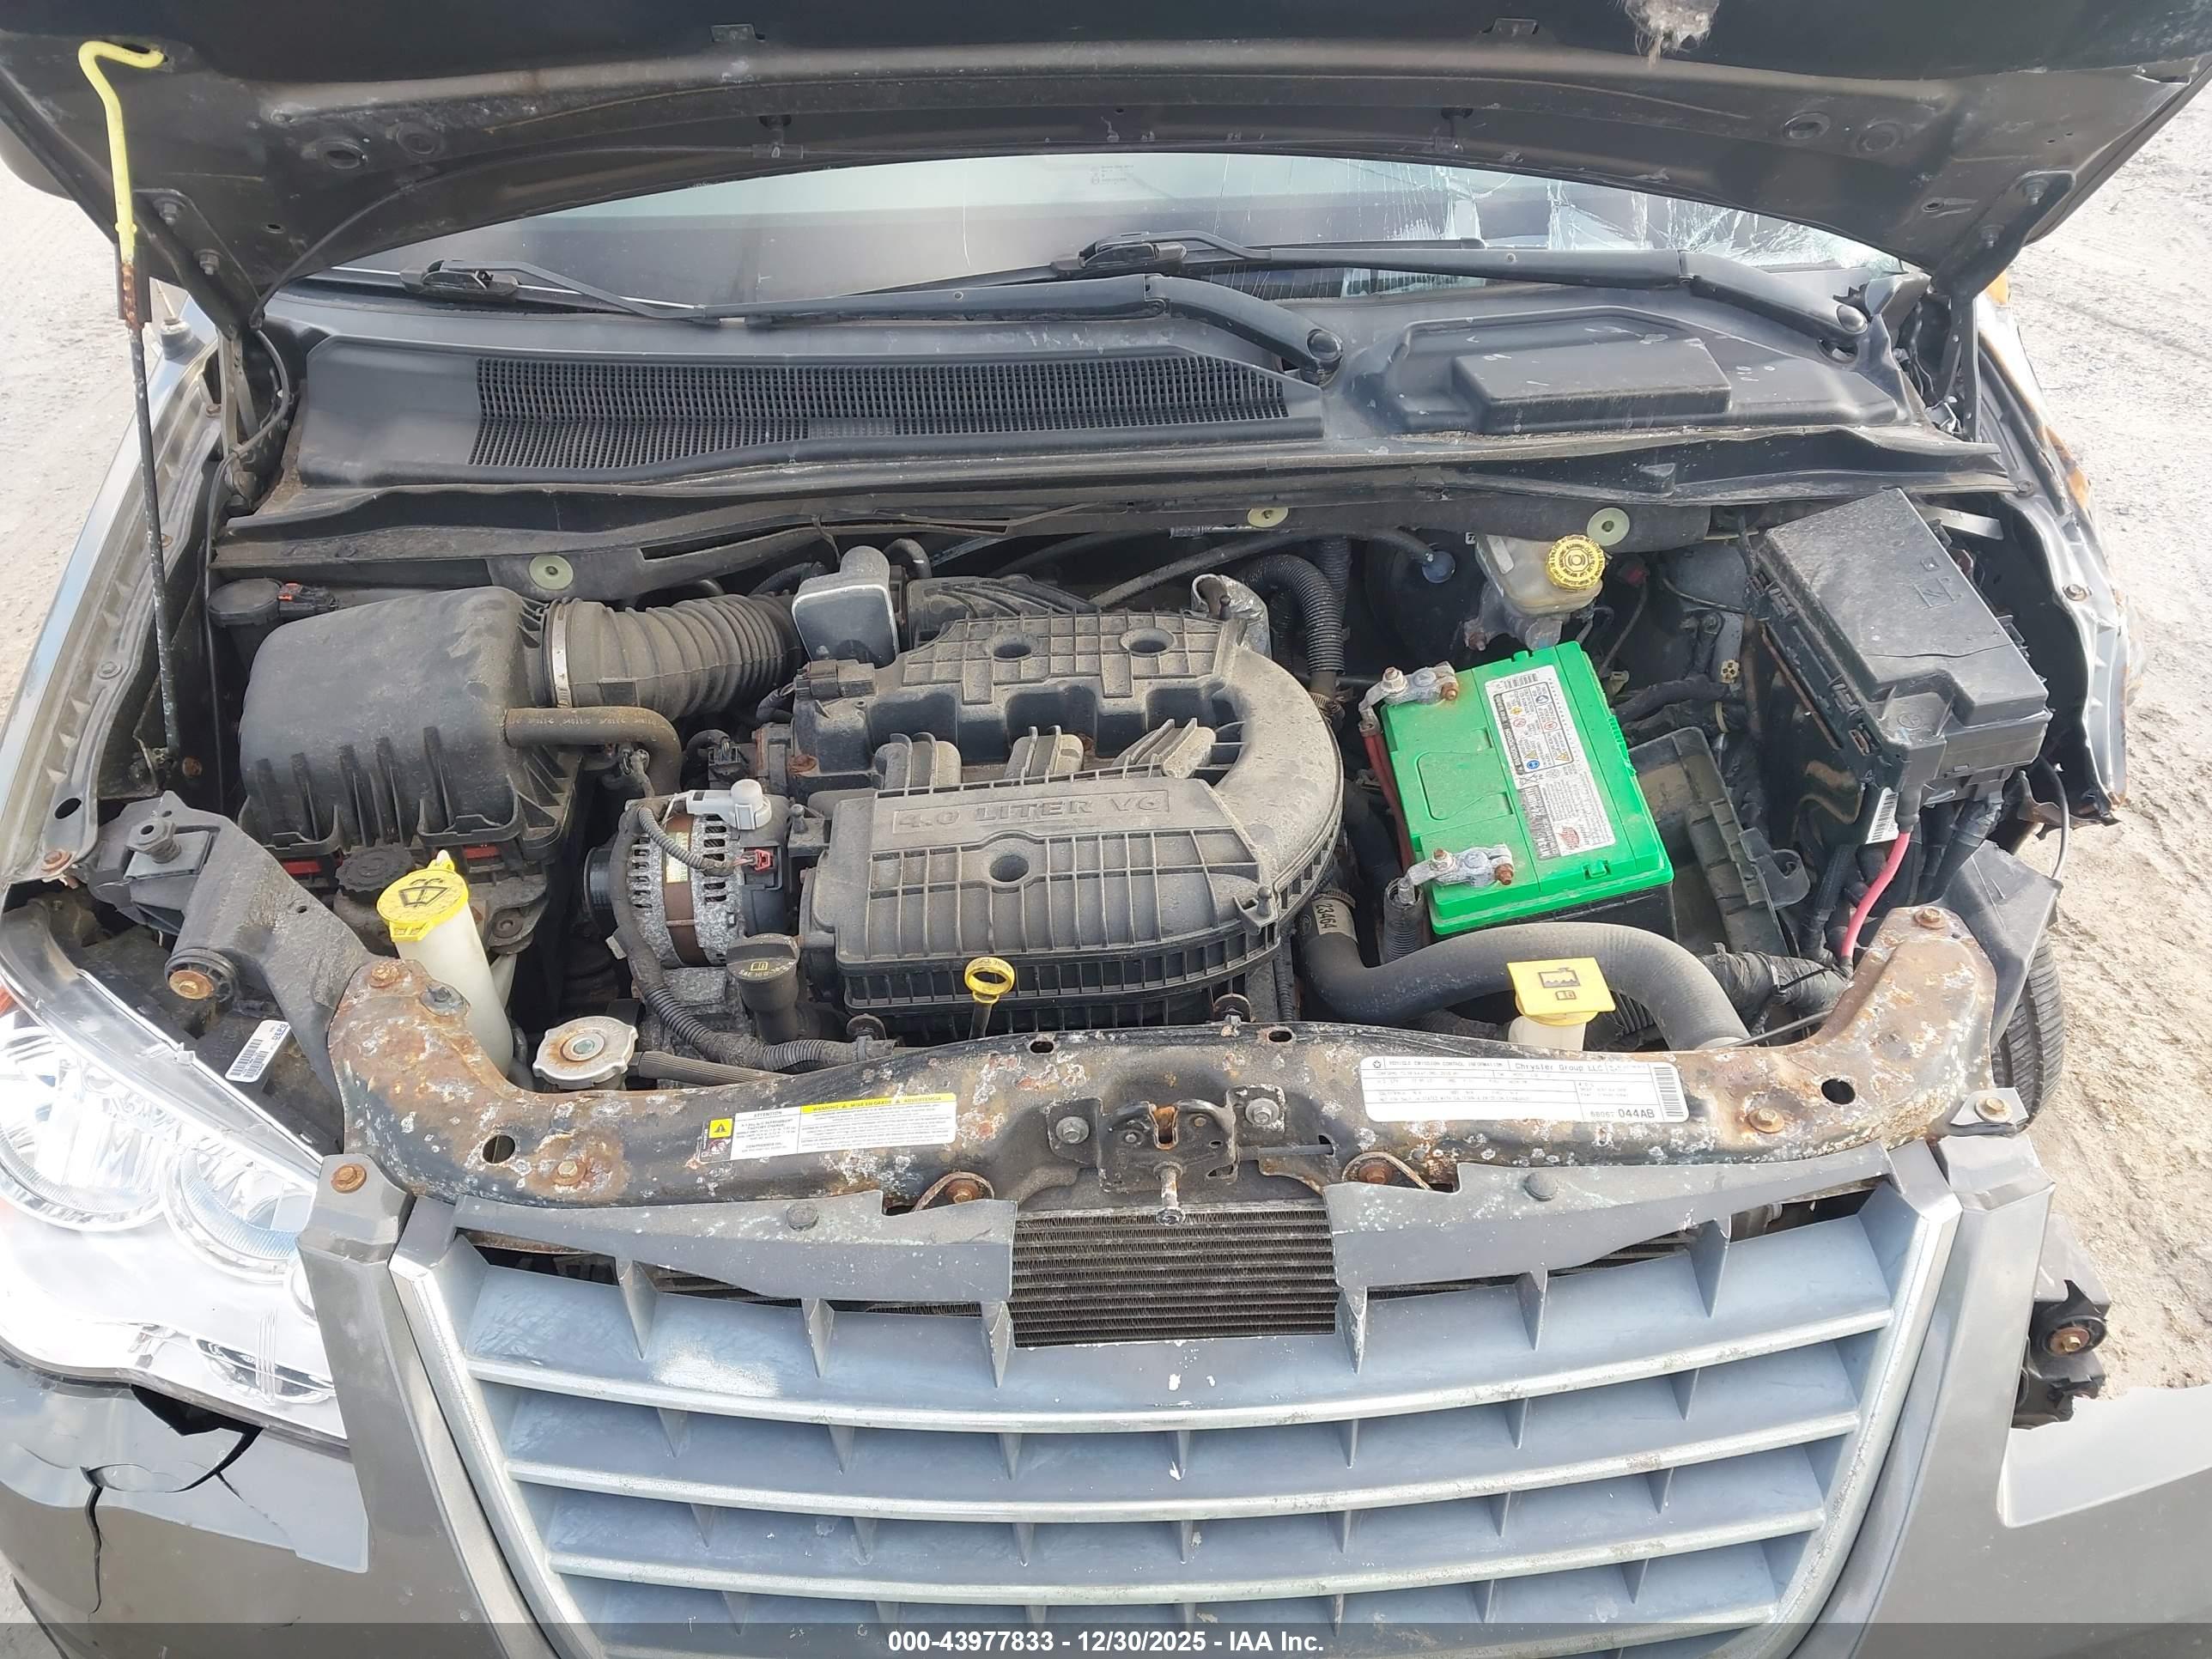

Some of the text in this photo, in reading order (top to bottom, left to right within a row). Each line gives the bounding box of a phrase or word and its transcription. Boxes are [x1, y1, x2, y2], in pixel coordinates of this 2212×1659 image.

[975, 799, 1093, 822] LITER
[1110, 795, 1161, 811] V6
[1316, 903, 1338, 929] 23464
[1515, 1063, 1554, 1072] Chrysler
[1559, 1064, 1584, 1073] Group
[1618, 1109, 1655, 1118] 044AB
